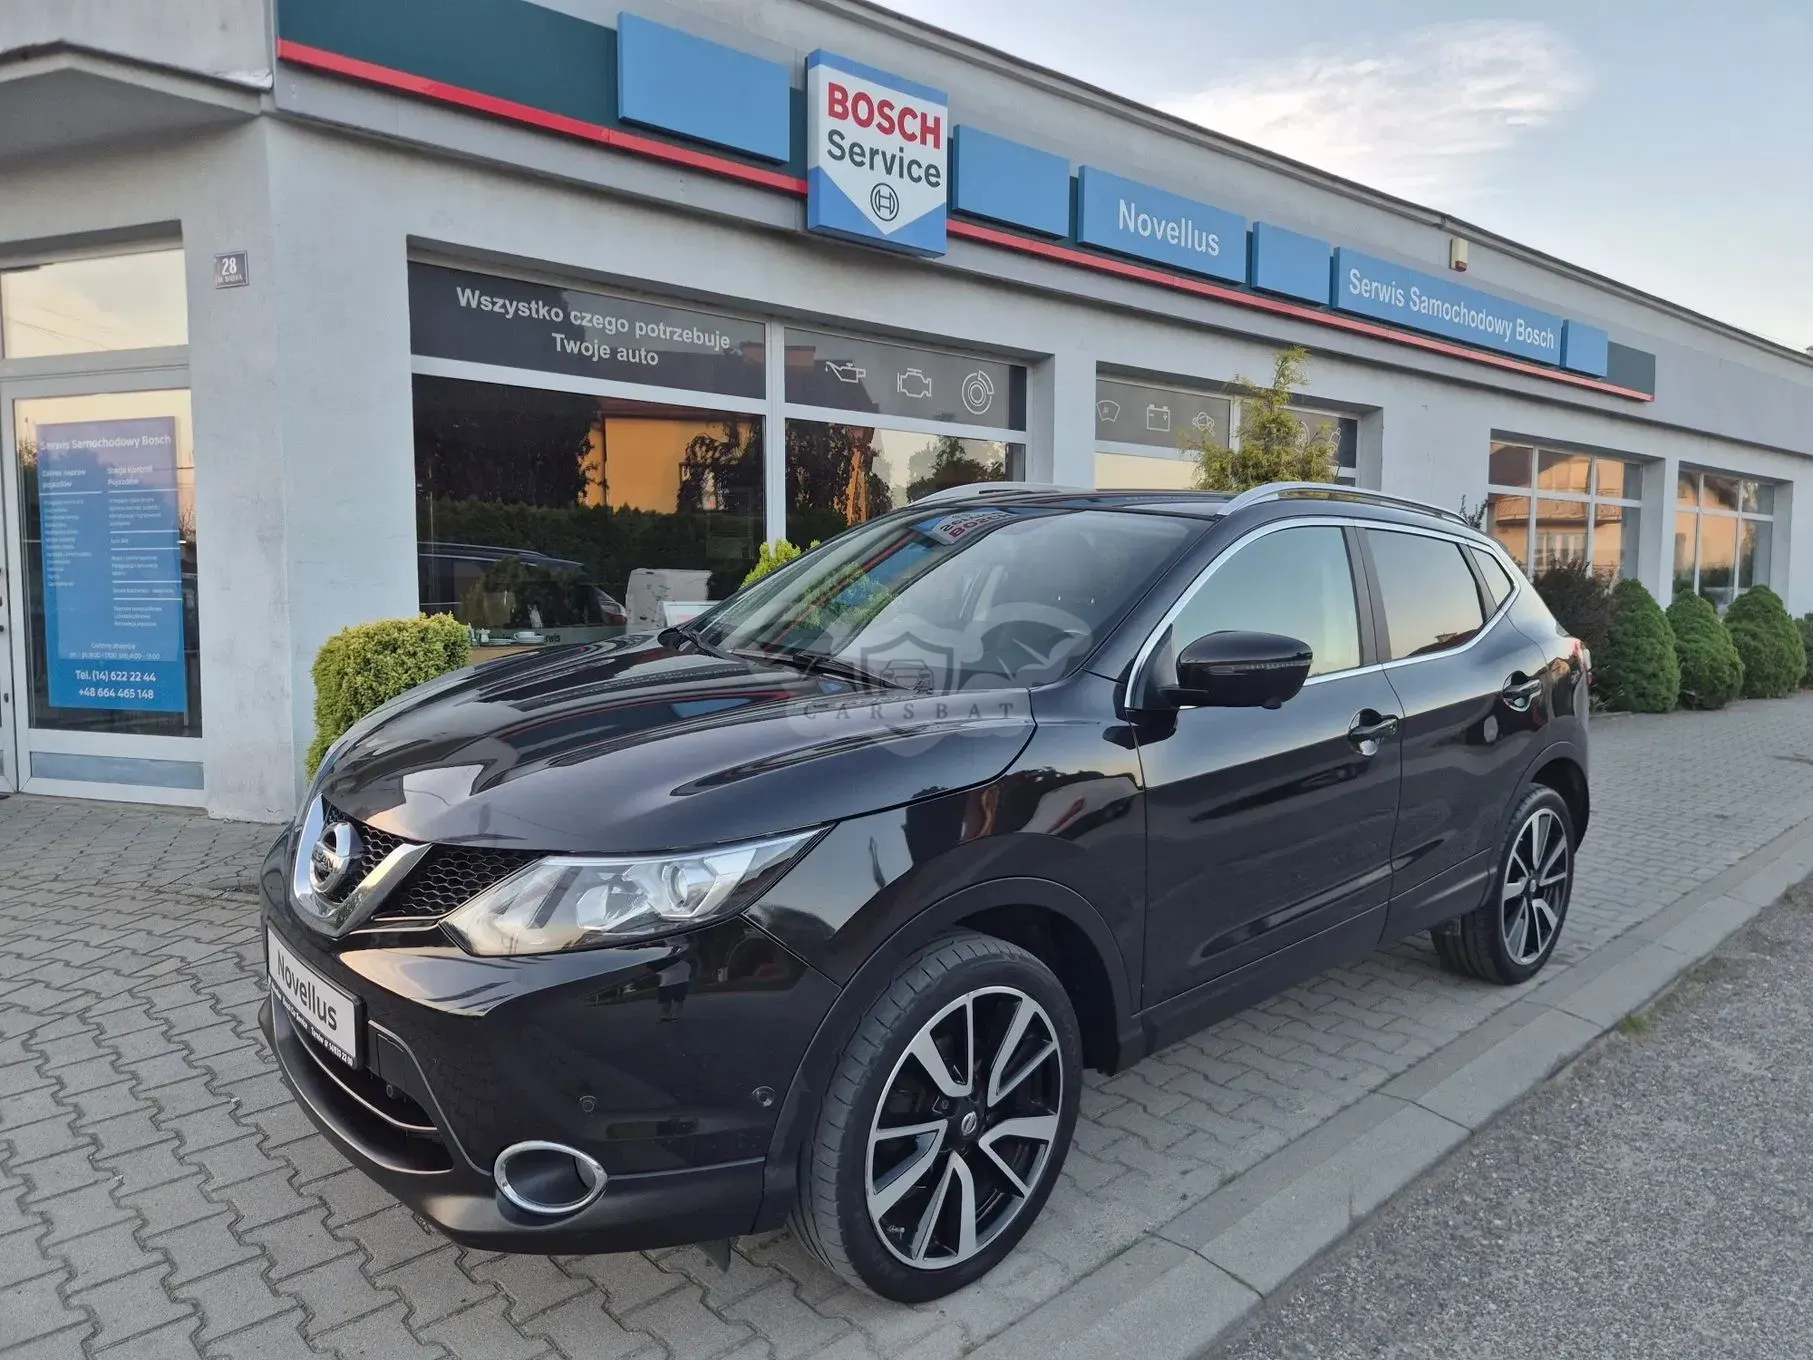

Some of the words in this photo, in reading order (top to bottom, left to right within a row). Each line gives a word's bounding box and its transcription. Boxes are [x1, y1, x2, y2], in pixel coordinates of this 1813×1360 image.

[827, 82, 941, 149] BOSCH
[826, 129, 941, 188] Service
[1118, 199, 1220, 257] Novellus
[222, 257, 237, 275] 28
[456, 286, 564, 323] Wszystko
[570, 310, 629, 336] czego
[635, 320, 731, 351] potrzebuje
[1349, 268, 1405, 308] Serwis
[1410, 288, 1513, 343] Samochodowy
[1516, 319, 1555, 350] Bosch
[551, 333, 611, 362] Twoje
[617, 345, 659, 366] auto
[72, 437, 140, 449] Samochodowy
[142, 434, 172, 446] Bosch
[75, 670, 91, 679] Tel.
[92, 670, 109, 682] (14)
[110, 671, 127, 681] 622
[129, 672, 142, 681] 22
[143, 672, 156, 682] 44
[79, 687, 95, 697] +48
[97, 688, 116, 697] 664
[117, 688, 135, 698] 465
[137, 689, 154, 699] 148
[277, 949, 338, 1031] Novellus
